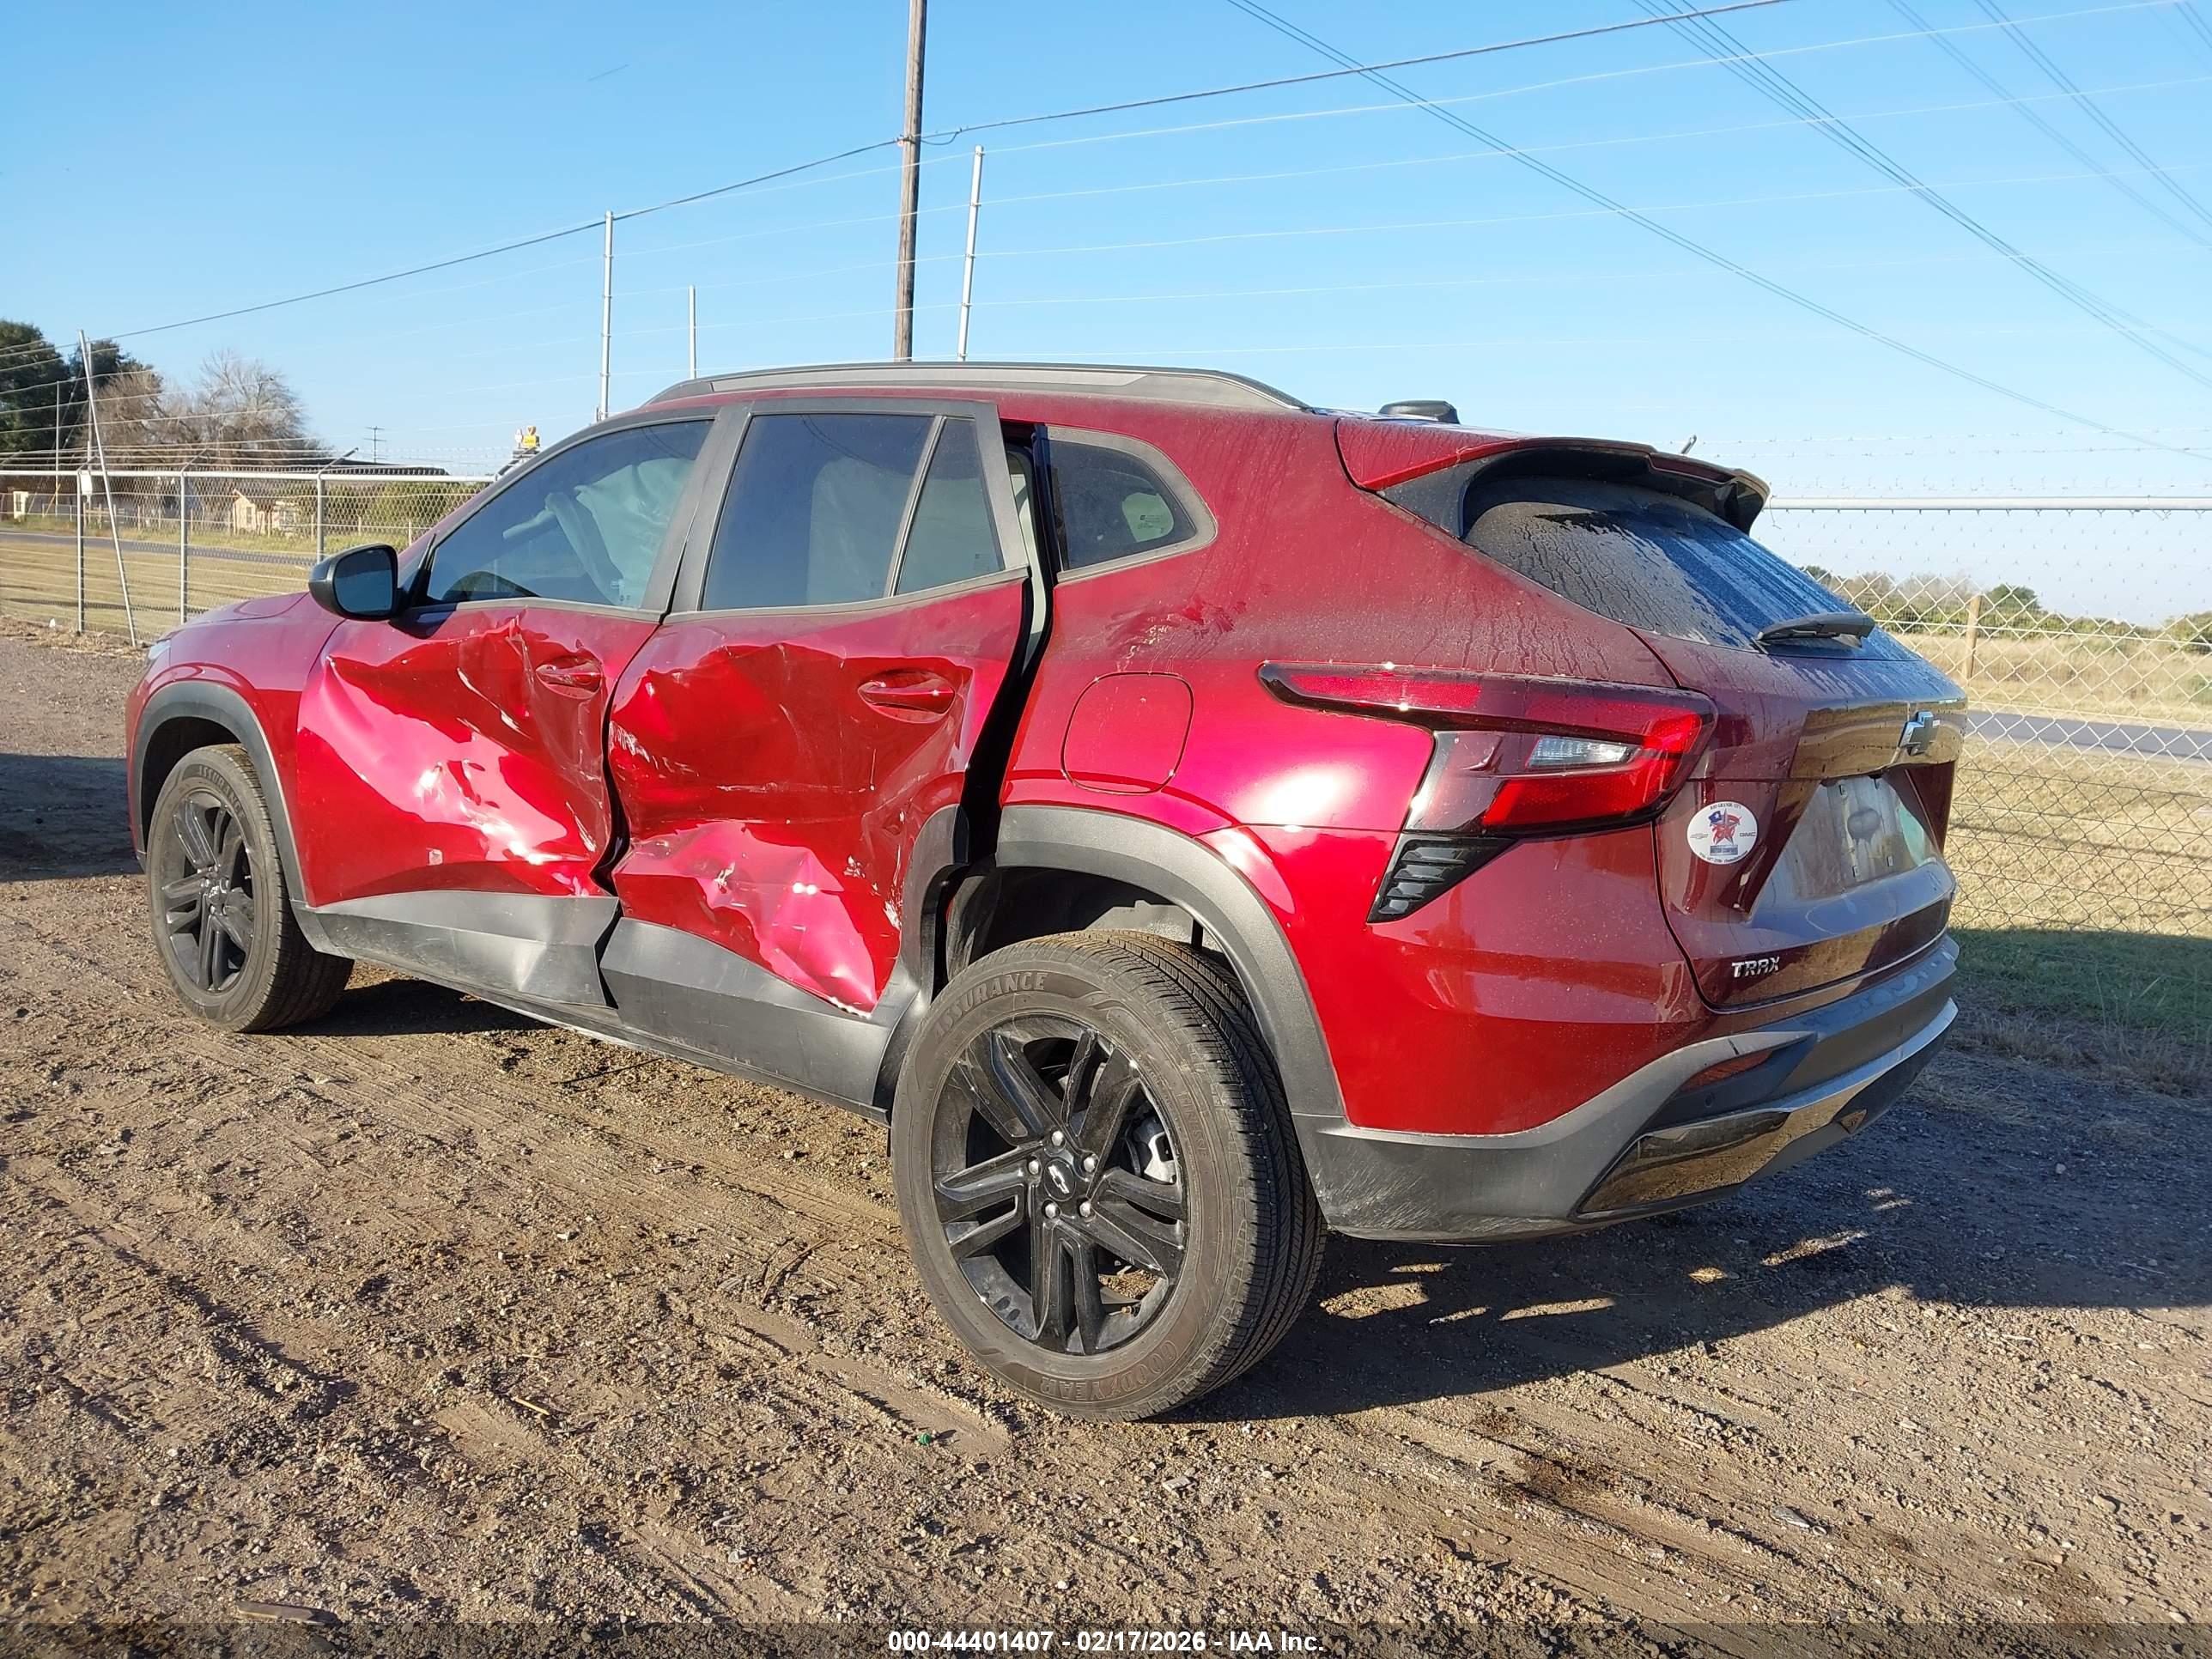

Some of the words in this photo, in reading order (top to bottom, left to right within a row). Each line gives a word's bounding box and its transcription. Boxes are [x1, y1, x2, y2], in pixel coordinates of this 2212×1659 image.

[1731, 956, 1780, 978] TRAX
[933, 971, 1048, 1039] ASSURANCE
[1040, 1340, 1178, 1402] GOODYEAR
